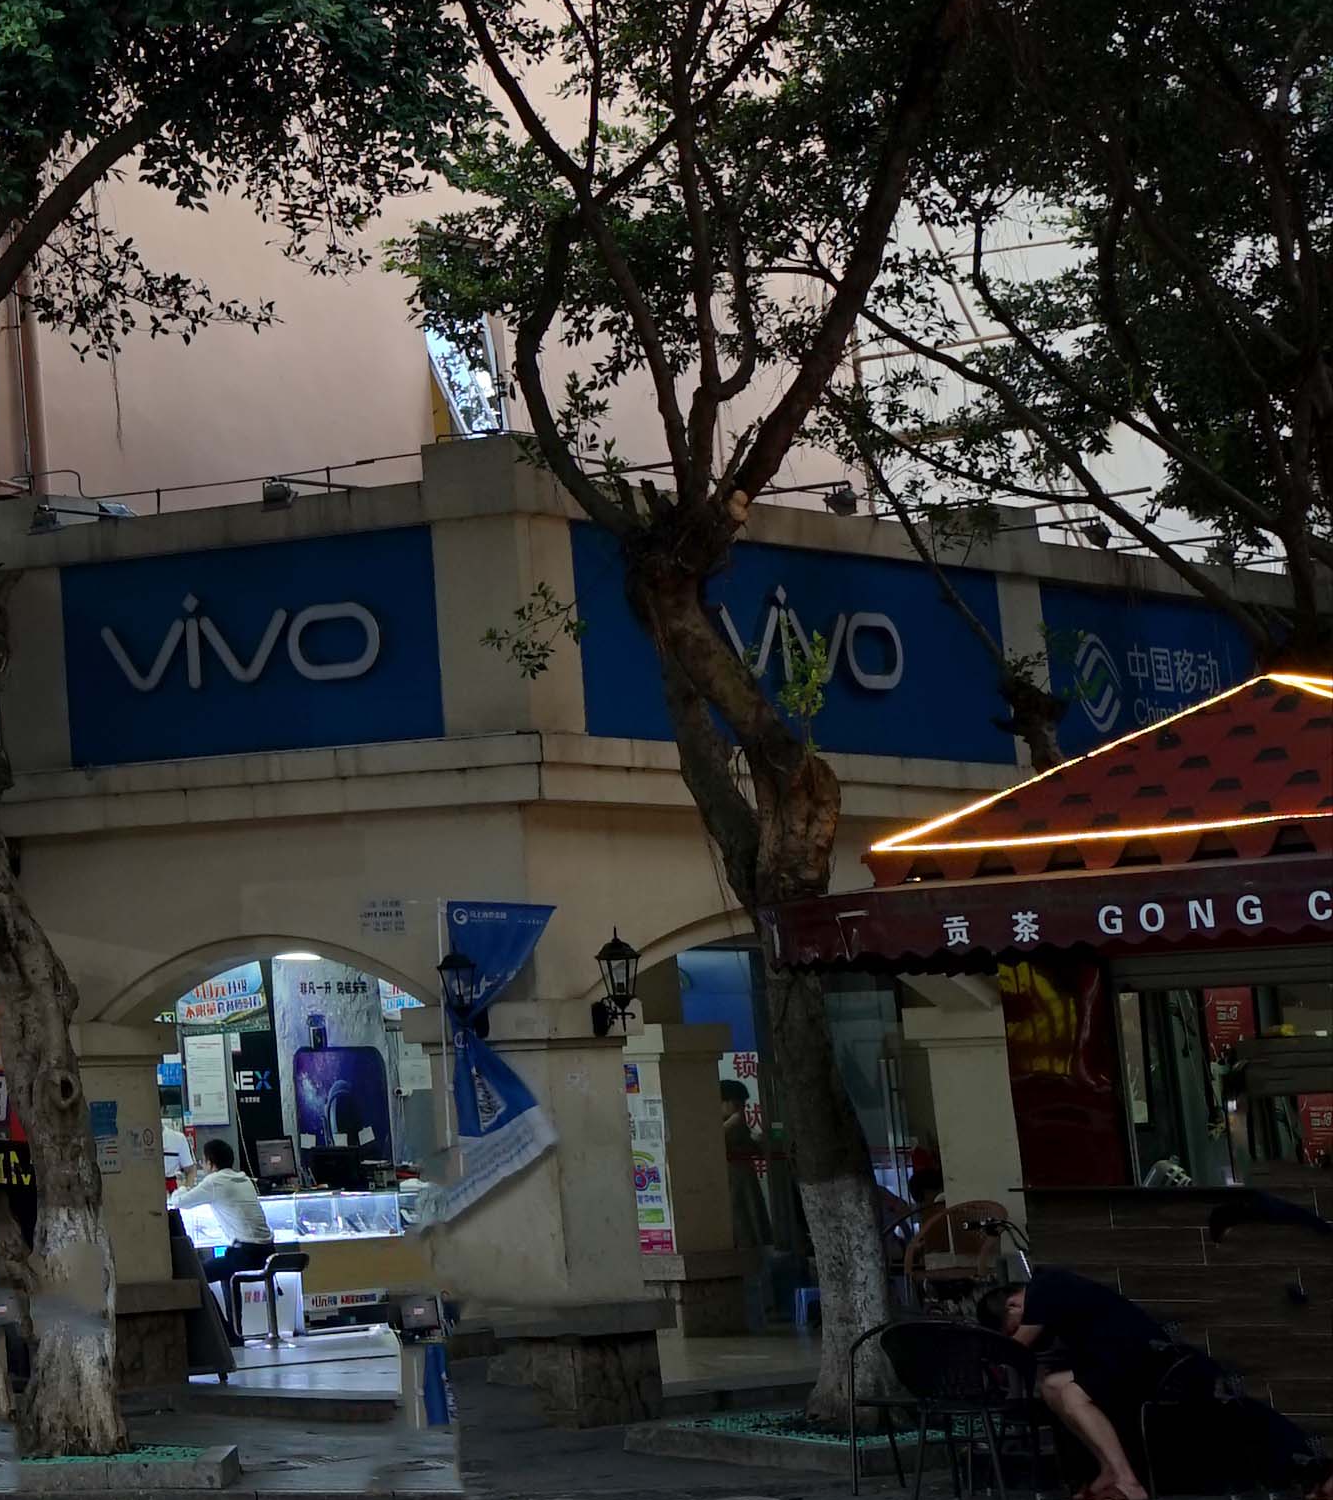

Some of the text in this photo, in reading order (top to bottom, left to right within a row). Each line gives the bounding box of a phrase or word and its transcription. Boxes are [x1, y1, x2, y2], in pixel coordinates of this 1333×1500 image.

[101, 593, 380, 692] vivo
[1126, 643, 1221, 695] 中国移动
[1097, 894, 1264, 935] GONG
